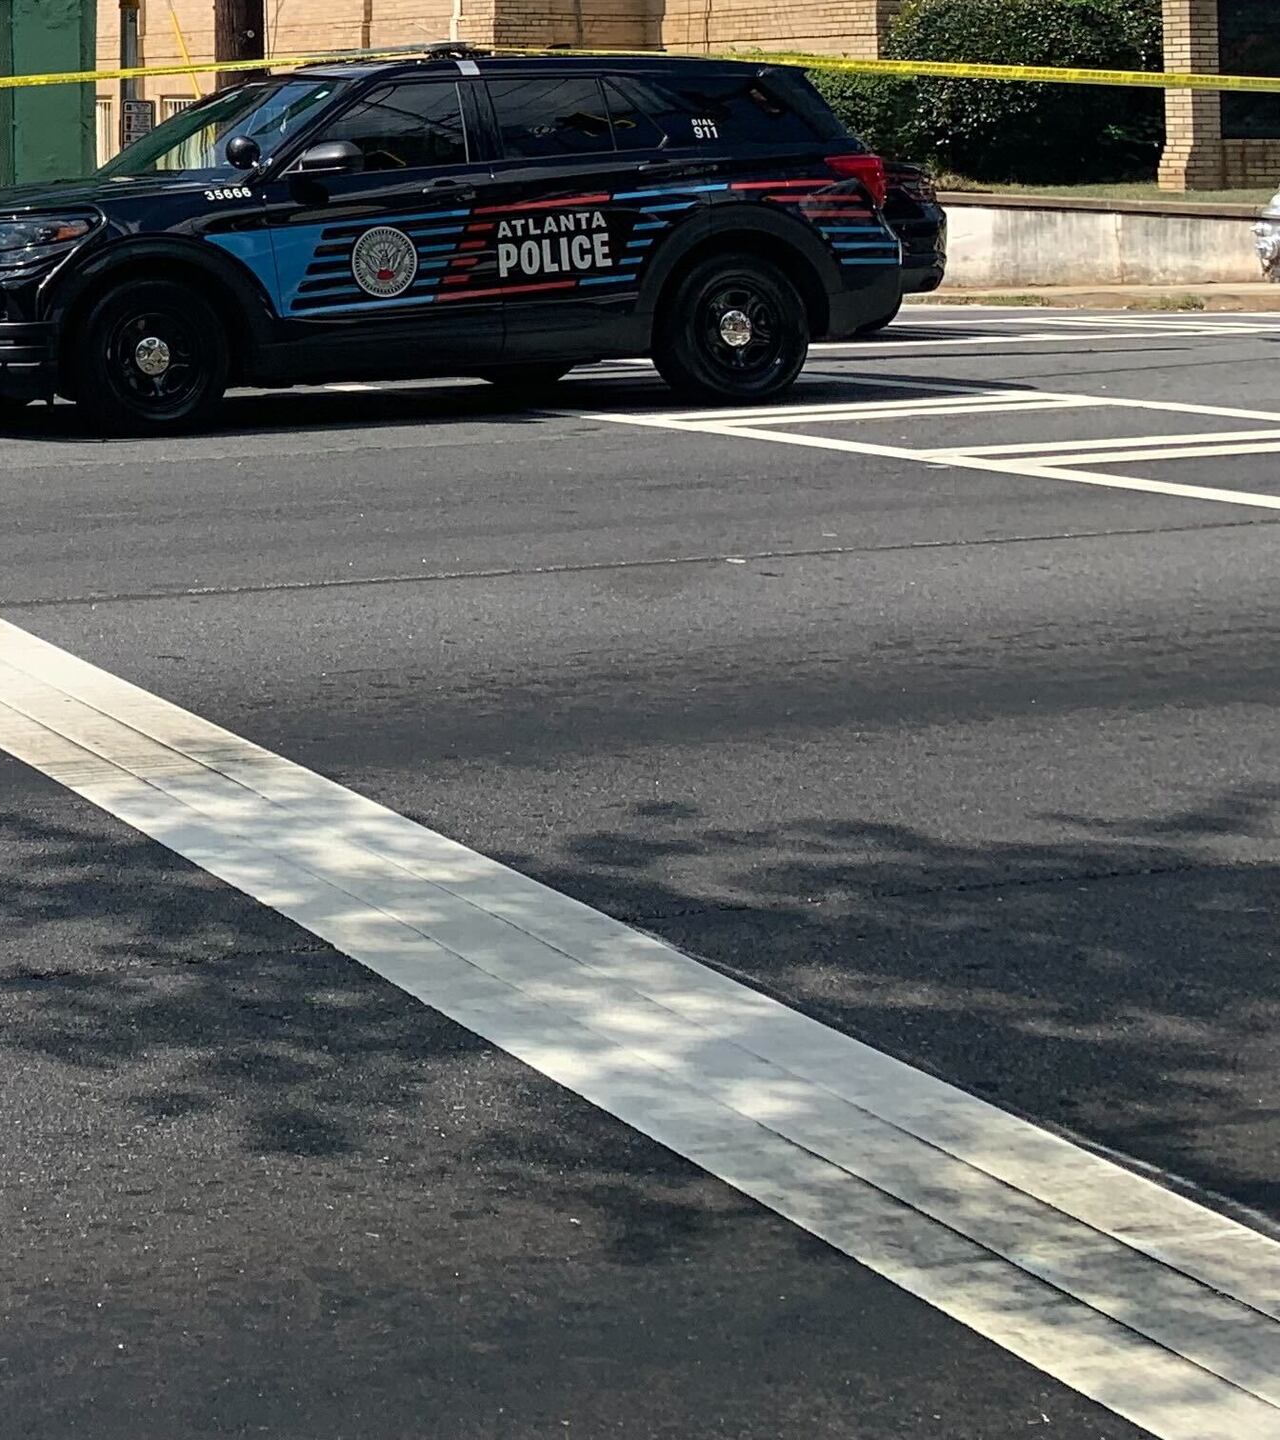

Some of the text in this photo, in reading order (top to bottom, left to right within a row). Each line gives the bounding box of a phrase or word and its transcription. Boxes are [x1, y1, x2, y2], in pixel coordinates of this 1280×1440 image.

[691, 118, 715, 126] DIAL
[693, 126, 719, 139] 911
[204, 187, 252, 201] 35666
[497, 211, 607, 238] ATLANTA
[498, 232, 613, 278] POLICE
